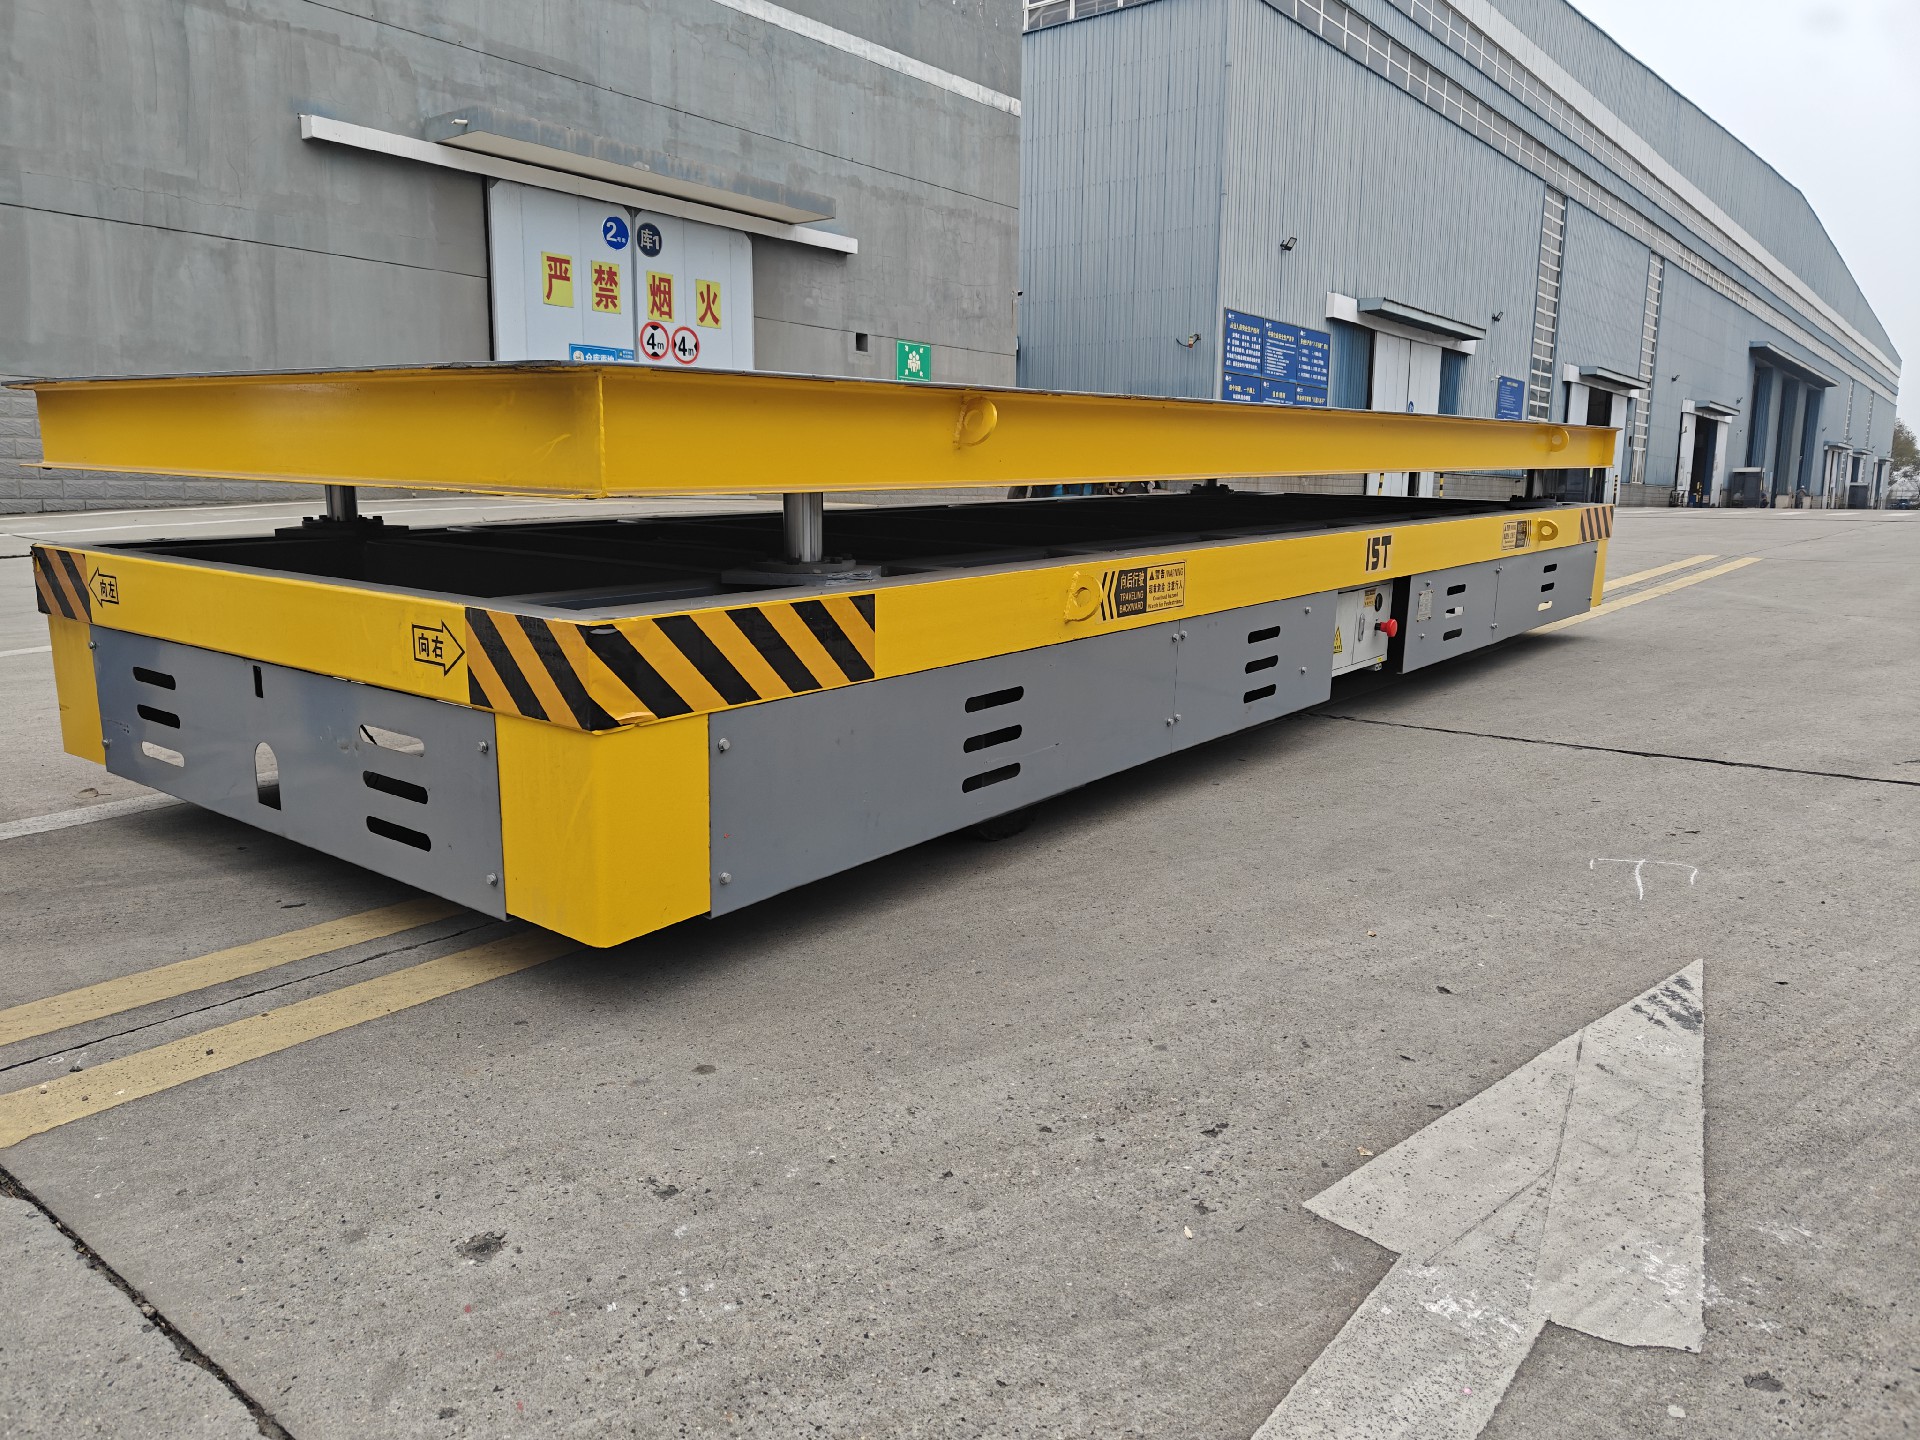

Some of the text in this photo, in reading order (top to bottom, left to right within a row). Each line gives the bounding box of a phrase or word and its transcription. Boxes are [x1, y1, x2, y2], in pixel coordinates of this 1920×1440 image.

[640, 228, 660, 250] 库1
[546, 255, 720, 326] 严禁烟火
[646, 332, 665, 351] 4m
[677, 336, 695, 356] 4m
[1365, 535, 1392, 572] IST
[1120, 570, 1145, 590] 向后行驶
[1155, 567, 1183, 580] 警告 WARNING
[99, 578, 116, 599] 向左
[1167, 580, 1182, 592] 注意行人
[1120, 601, 1144, 614] BACKWARD
[418, 632, 443, 660] 向右
